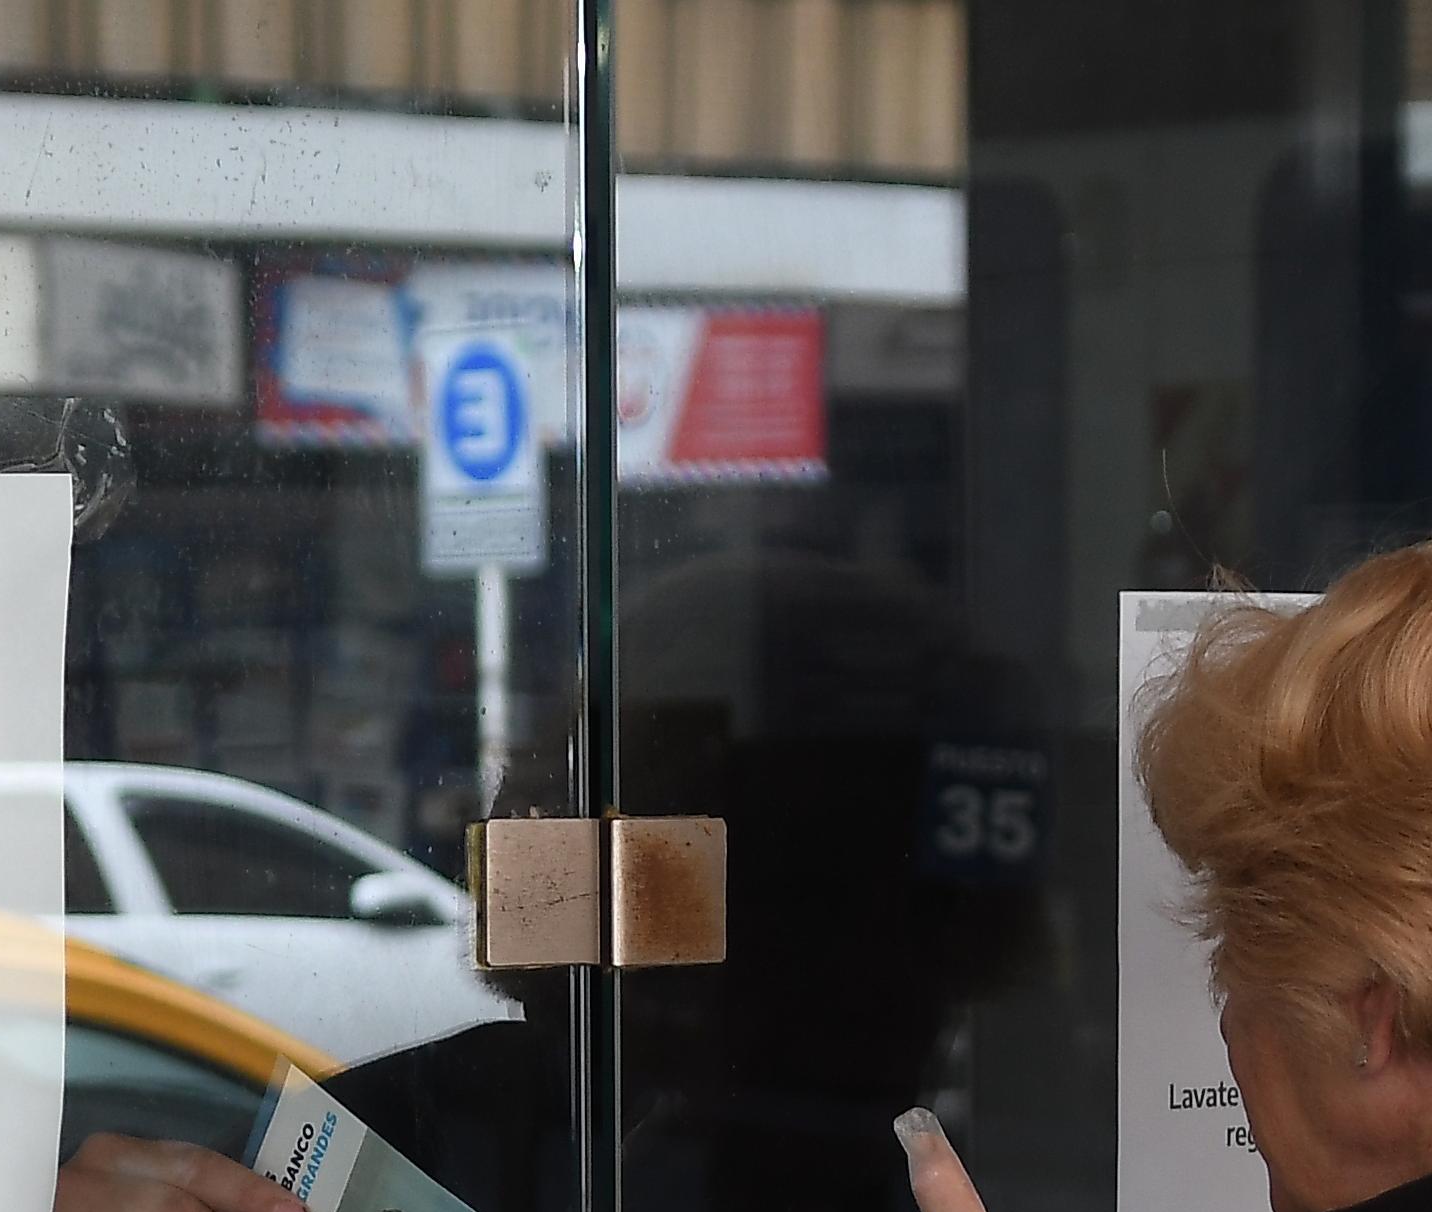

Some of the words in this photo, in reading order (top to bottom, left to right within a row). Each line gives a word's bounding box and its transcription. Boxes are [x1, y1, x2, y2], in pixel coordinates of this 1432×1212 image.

[937, 784, 1036, 862] 35
[1169, 1081, 1239, 1110] Lavate
[281, 1122, 315, 1192] BANCO
[297, 1111, 337, 1203] GRANDES
